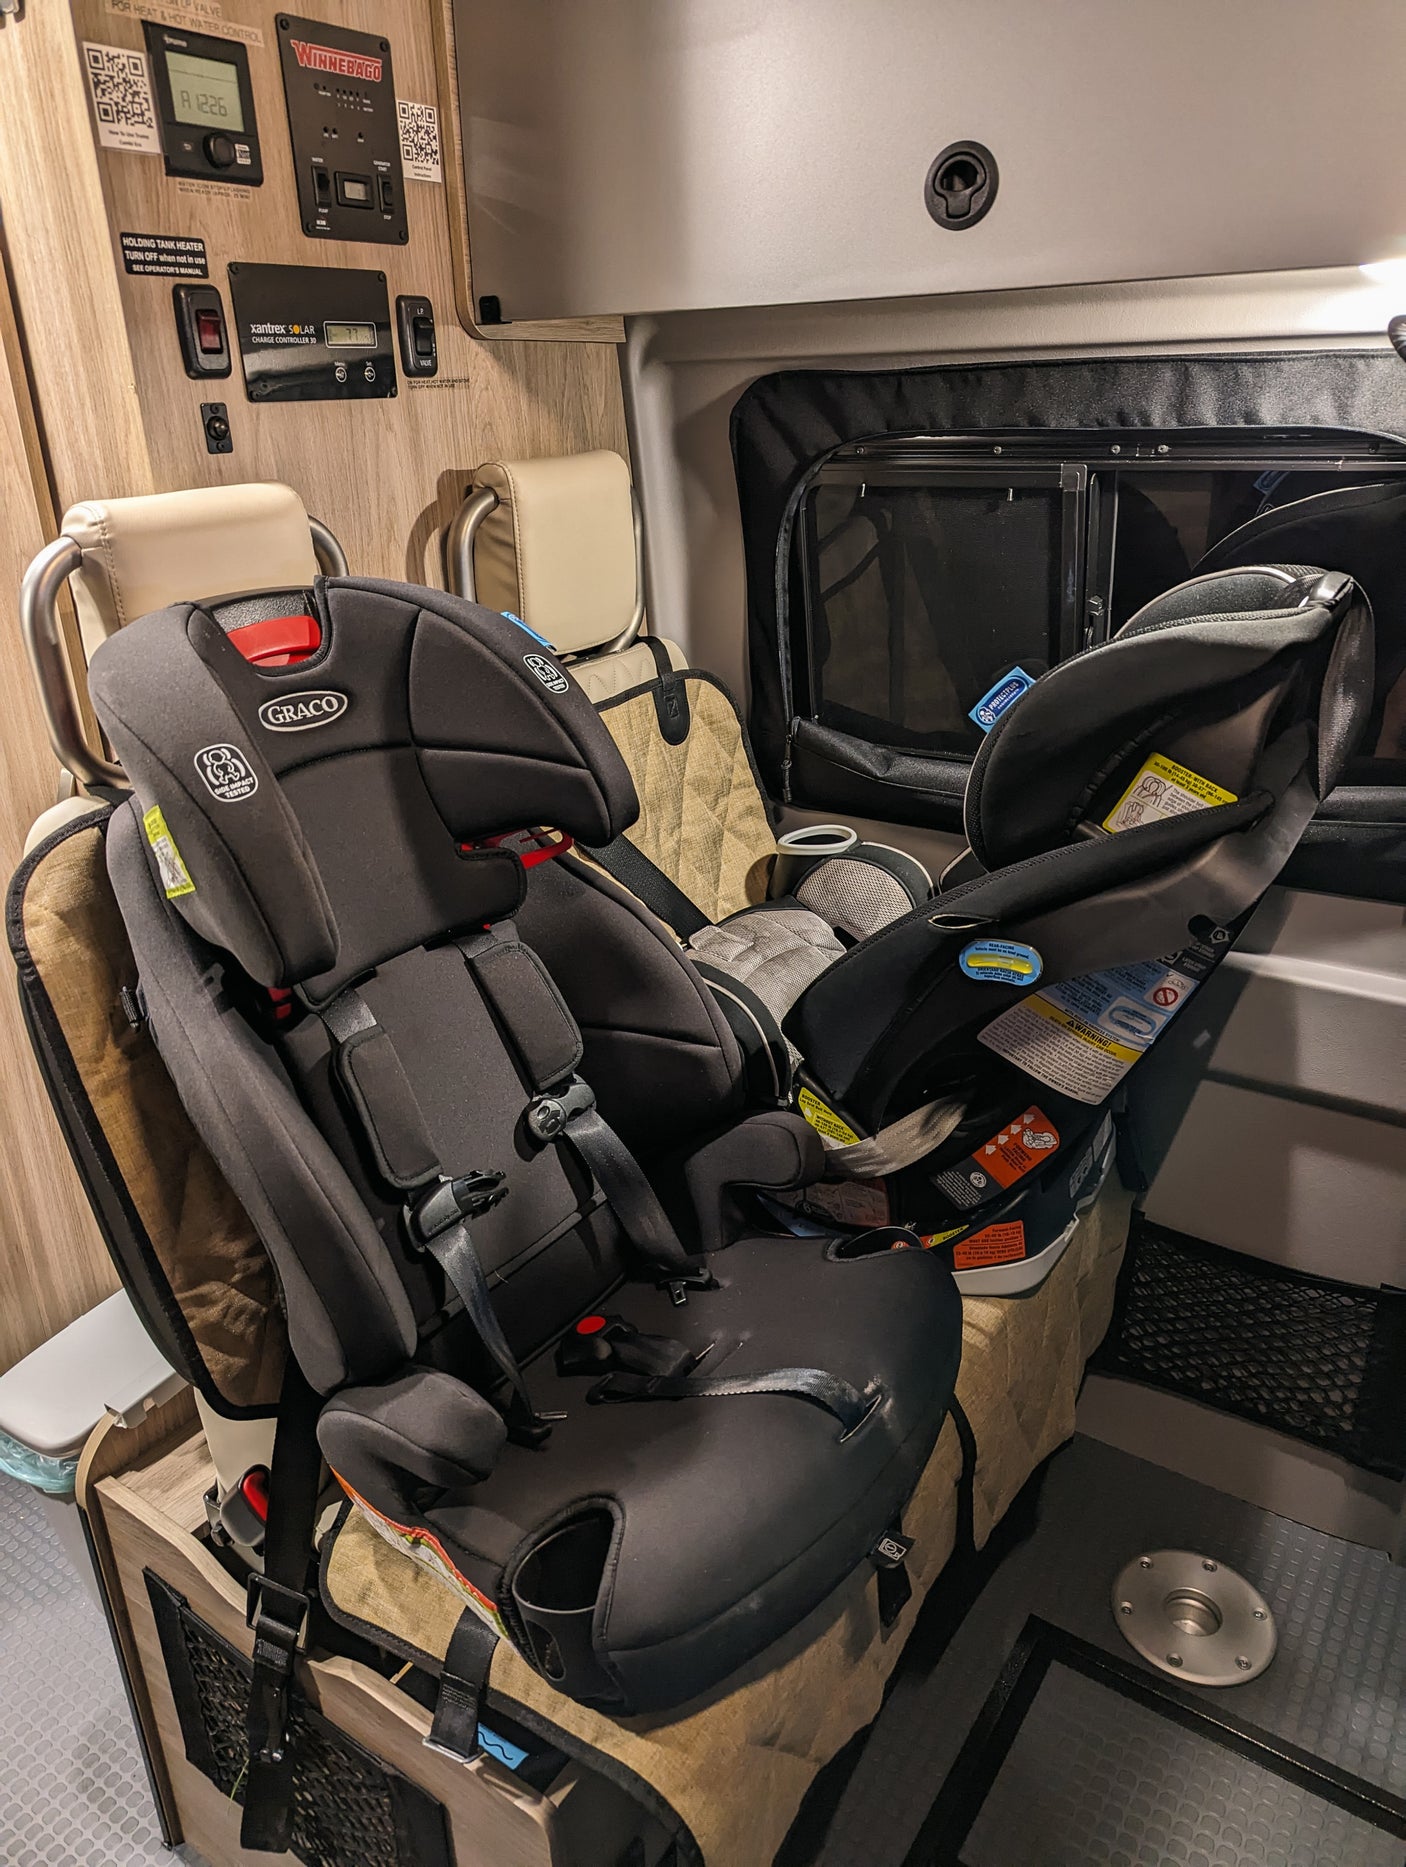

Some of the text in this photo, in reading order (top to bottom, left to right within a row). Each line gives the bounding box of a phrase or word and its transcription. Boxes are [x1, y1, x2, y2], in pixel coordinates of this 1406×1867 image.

[195, 3, 221, 16] VALVE
[111, 1, 262, 42] FOR HEAT & HOT WATER CONTROL
[290, 40, 381, 82] WINNEBAGO
[123, 237, 203, 251] HOLDING TANK HEATER
[125, 250, 144, 260] TURN
[145, 252, 158, 261] OFF
[159, 254, 175, 262] when
[176, 254, 187, 263] not
[188, 255, 194, 263] in
[132, 264, 143, 272] SEE
[145, 265, 179, 273] OPERATOR'S
[250, 322, 315, 335] xantrex SOLAR
[252, 336, 274, 344] CHARGE
[989, 681, 1017, 708] PROTECTPLUS
[268, 696, 338, 724] GRACO
[215, 777, 254, 795] SIDE IMPACT
[225, 786, 250, 798] TESTED
[1205, 784, 1217, 792] BACK
[1074, 1024, 1111, 1047] WARNING!
[802, 1093, 820, 1106] BOOSTER
